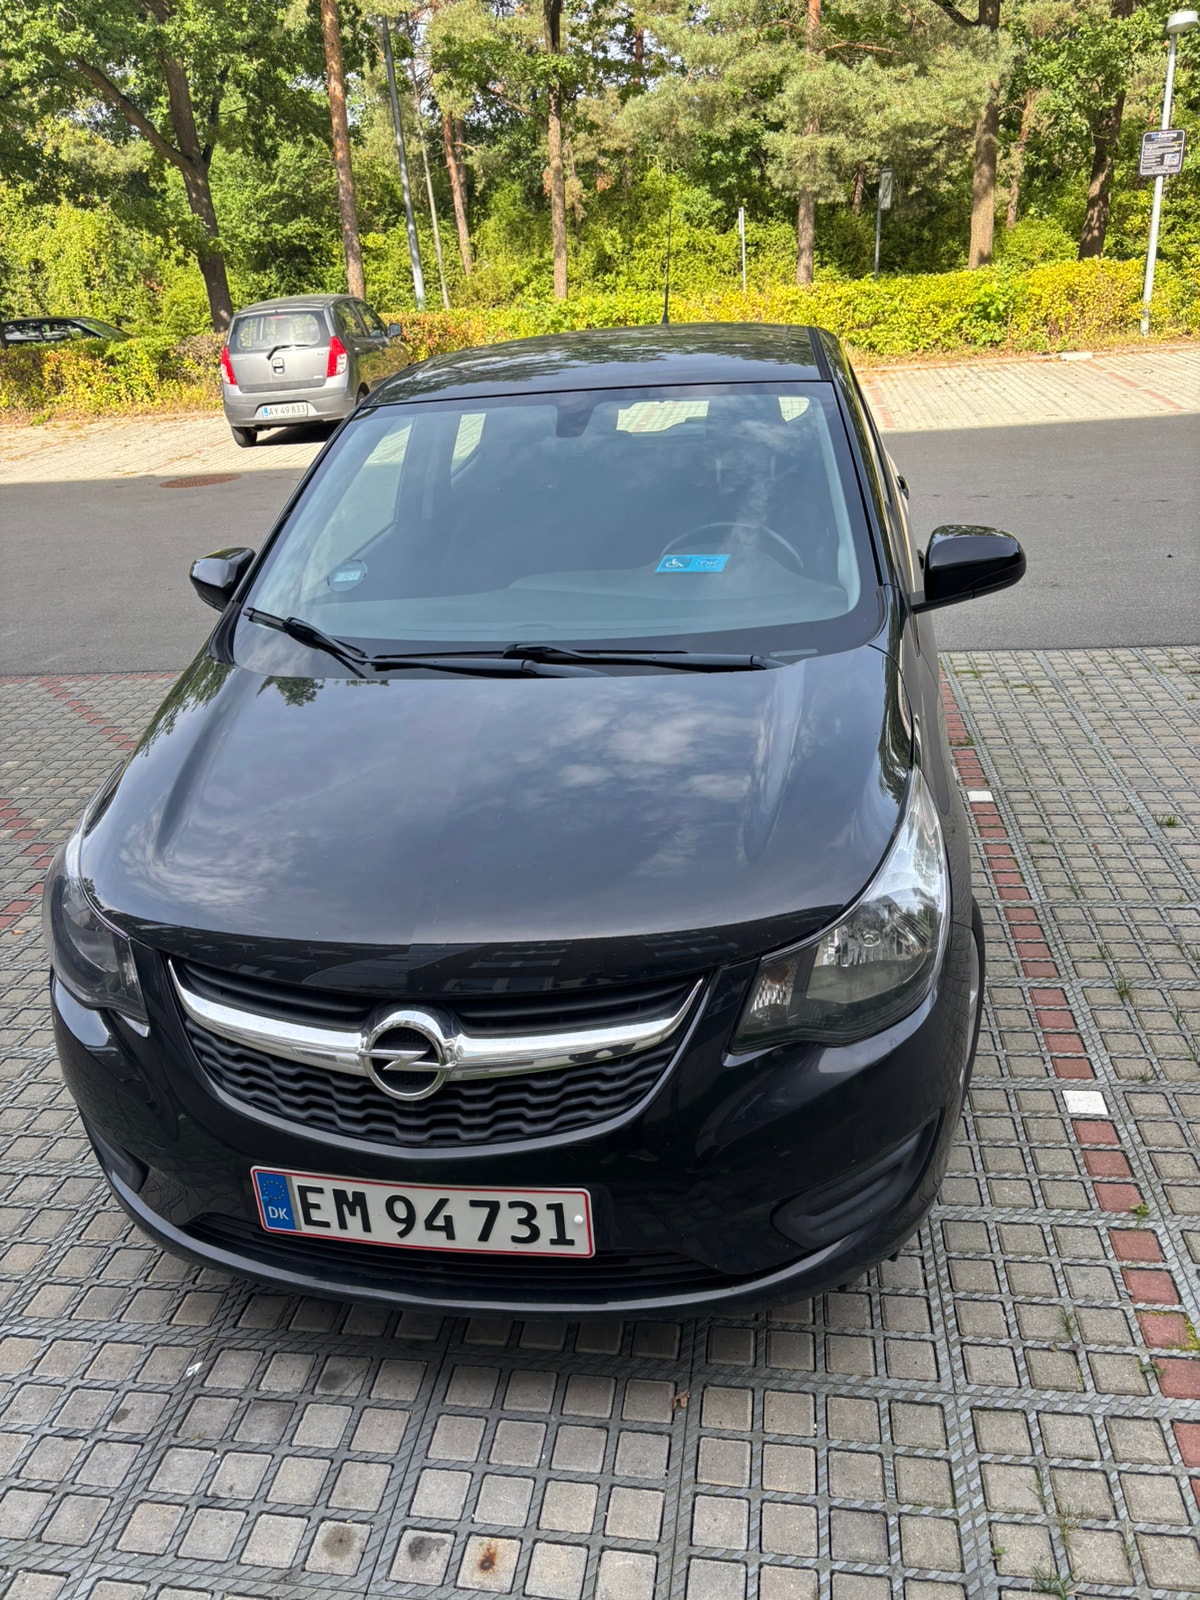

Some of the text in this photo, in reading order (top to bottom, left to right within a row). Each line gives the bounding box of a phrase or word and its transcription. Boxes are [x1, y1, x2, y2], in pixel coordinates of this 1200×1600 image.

[268, 407, 279, 416] AY
[280, 406, 290, 415] 49
[290, 404, 306, 414] 833
[267, 1206, 290, 1221] DK
[296, 1184, 576, 1247] EM 94 731
